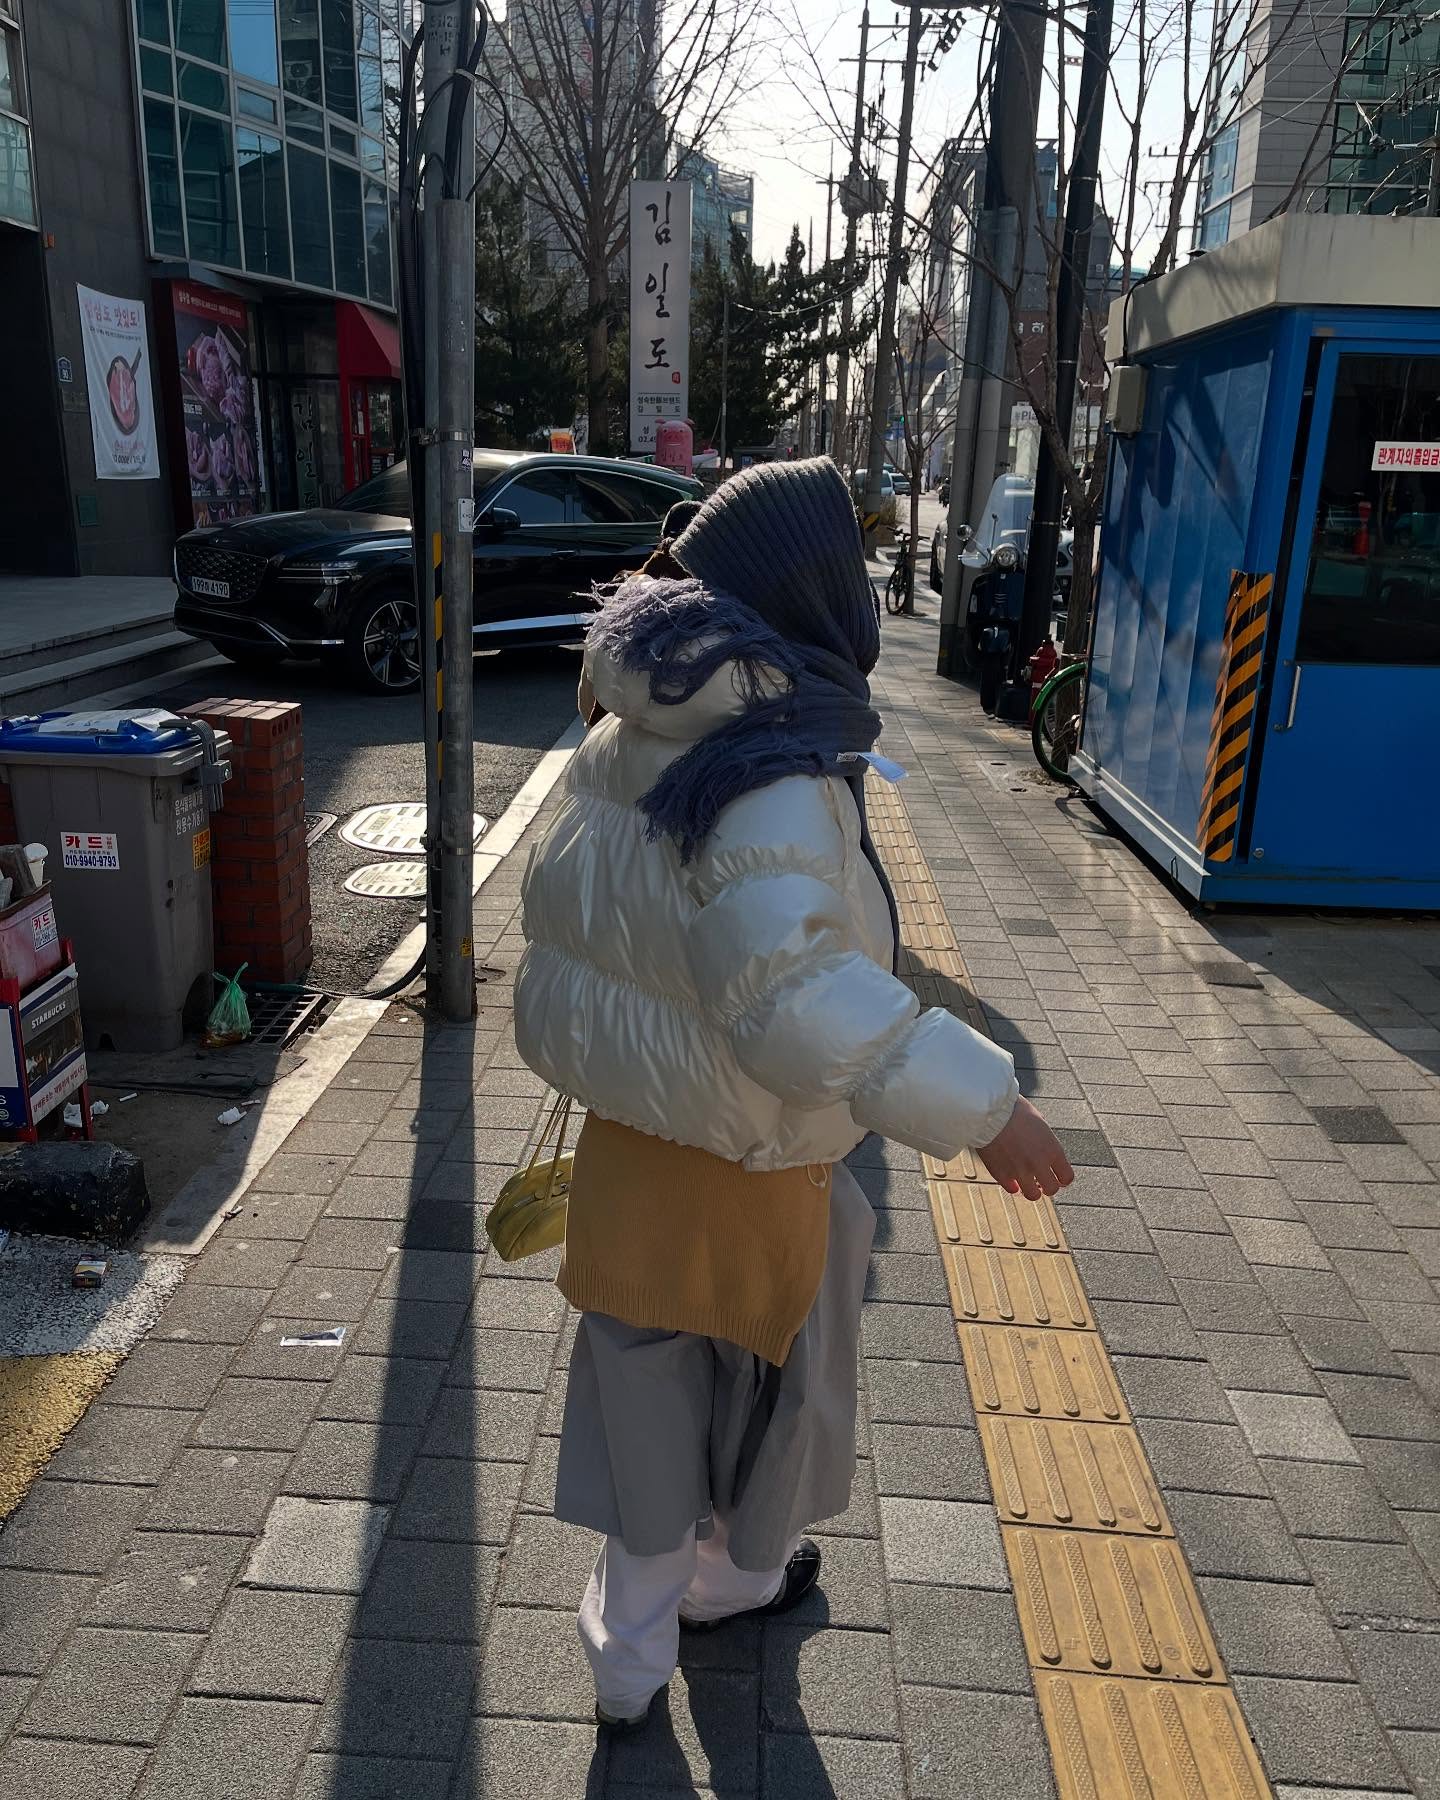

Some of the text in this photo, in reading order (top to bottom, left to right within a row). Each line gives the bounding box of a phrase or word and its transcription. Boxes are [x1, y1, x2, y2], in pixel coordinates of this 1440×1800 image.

[645, 191, 672, 368] 김일도
[1378, 448, 1440, 465] 관계자외출입금
[65, 835, 102, 848] 카드
[65, 854, 117, 867] 010-9940-9793
[31, 1000, 66, 1029] STARBUCKS
